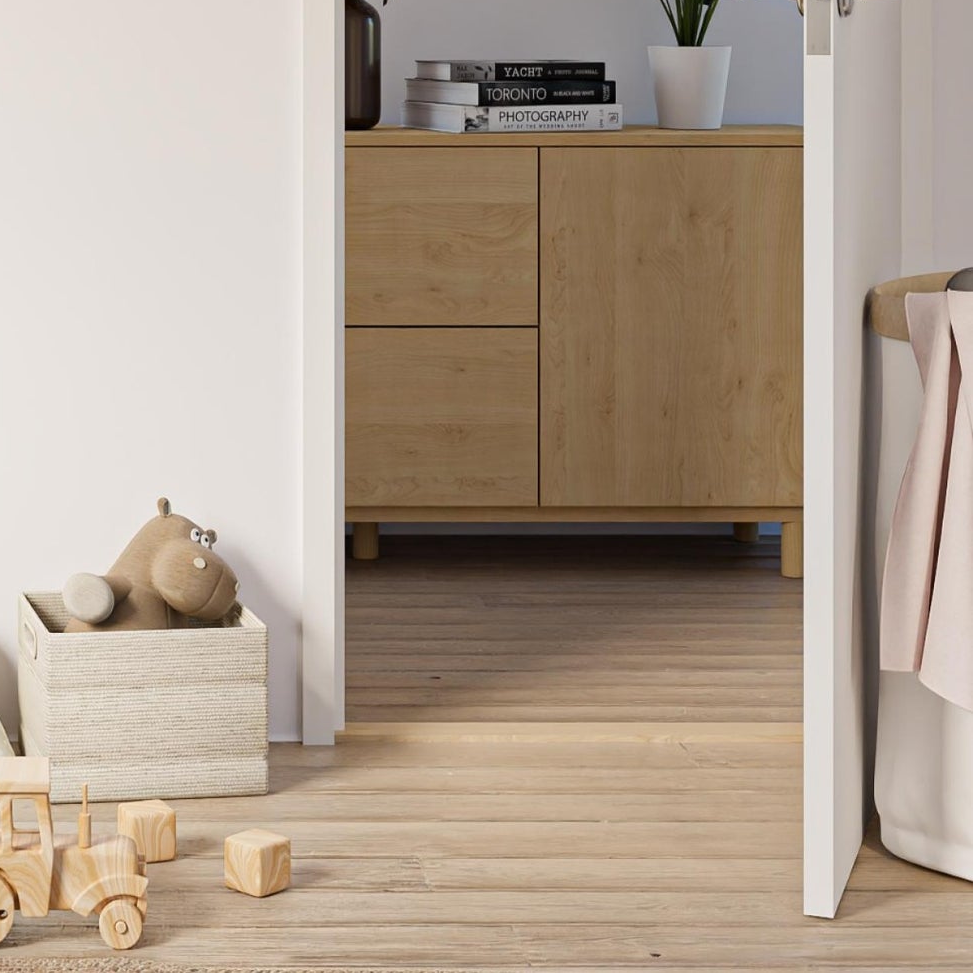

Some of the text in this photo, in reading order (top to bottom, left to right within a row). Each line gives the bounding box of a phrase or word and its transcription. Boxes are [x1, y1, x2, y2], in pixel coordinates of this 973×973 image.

[503, 66, 544, 78] YACHT
[486, 87, 547, 102] TORONTO
[498, 110, 589, 123] PHOTOGRAPHY
